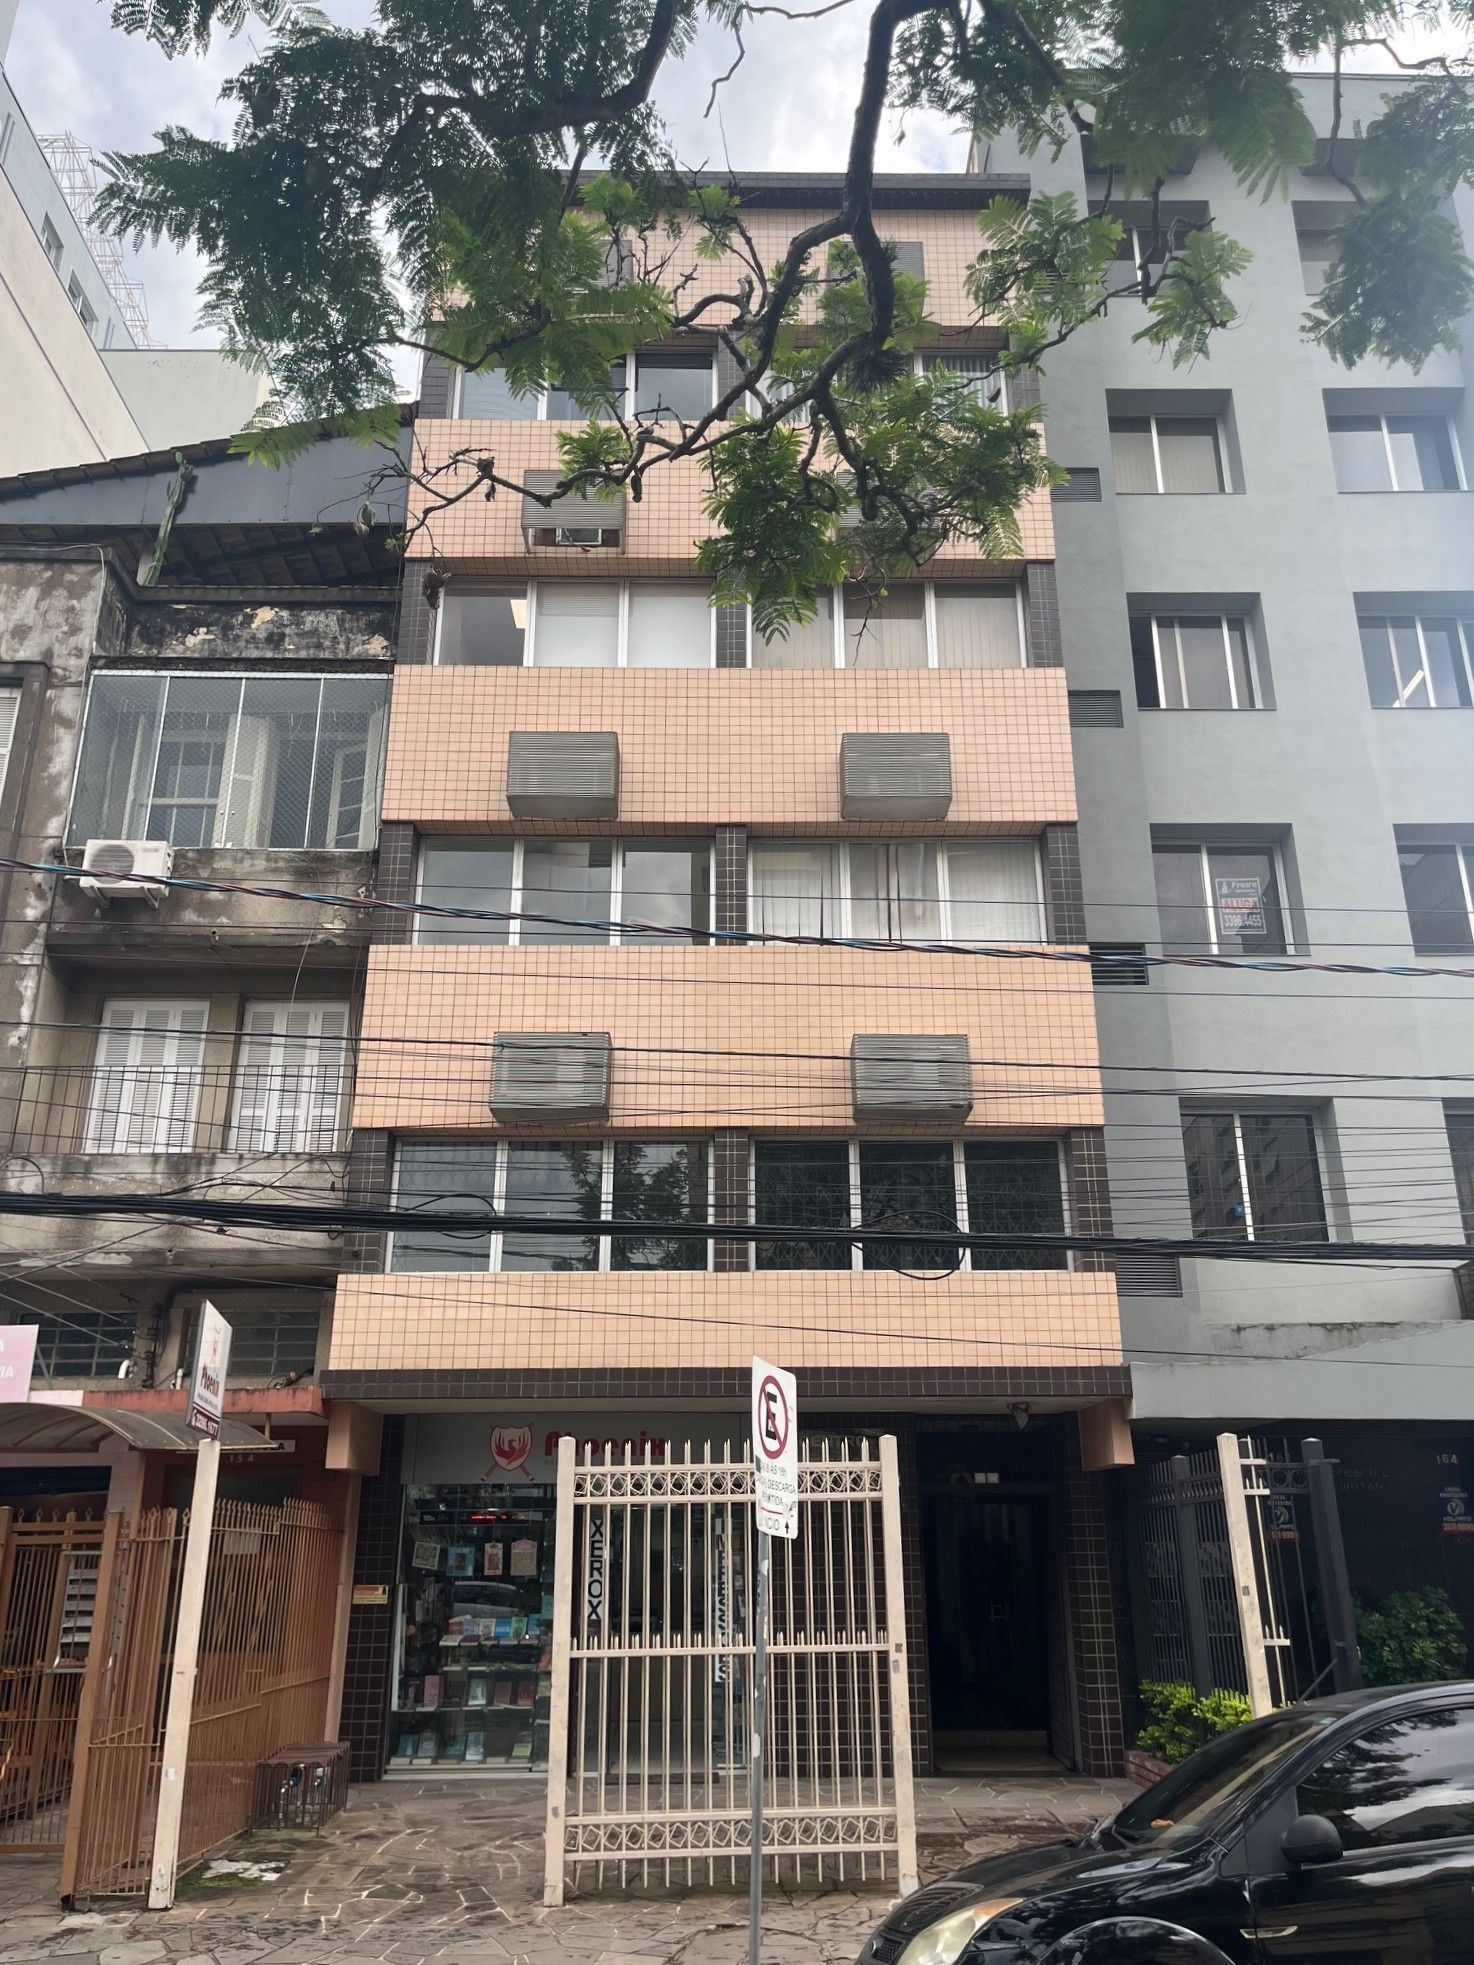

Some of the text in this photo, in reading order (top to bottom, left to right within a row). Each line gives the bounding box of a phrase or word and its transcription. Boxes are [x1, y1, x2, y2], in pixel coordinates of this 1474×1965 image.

[1436, 1453, 1459, 1465] 164
[767, 1479, 796, 1494] DESCARGA
[587, 1519, 604, 1619] XEROX
